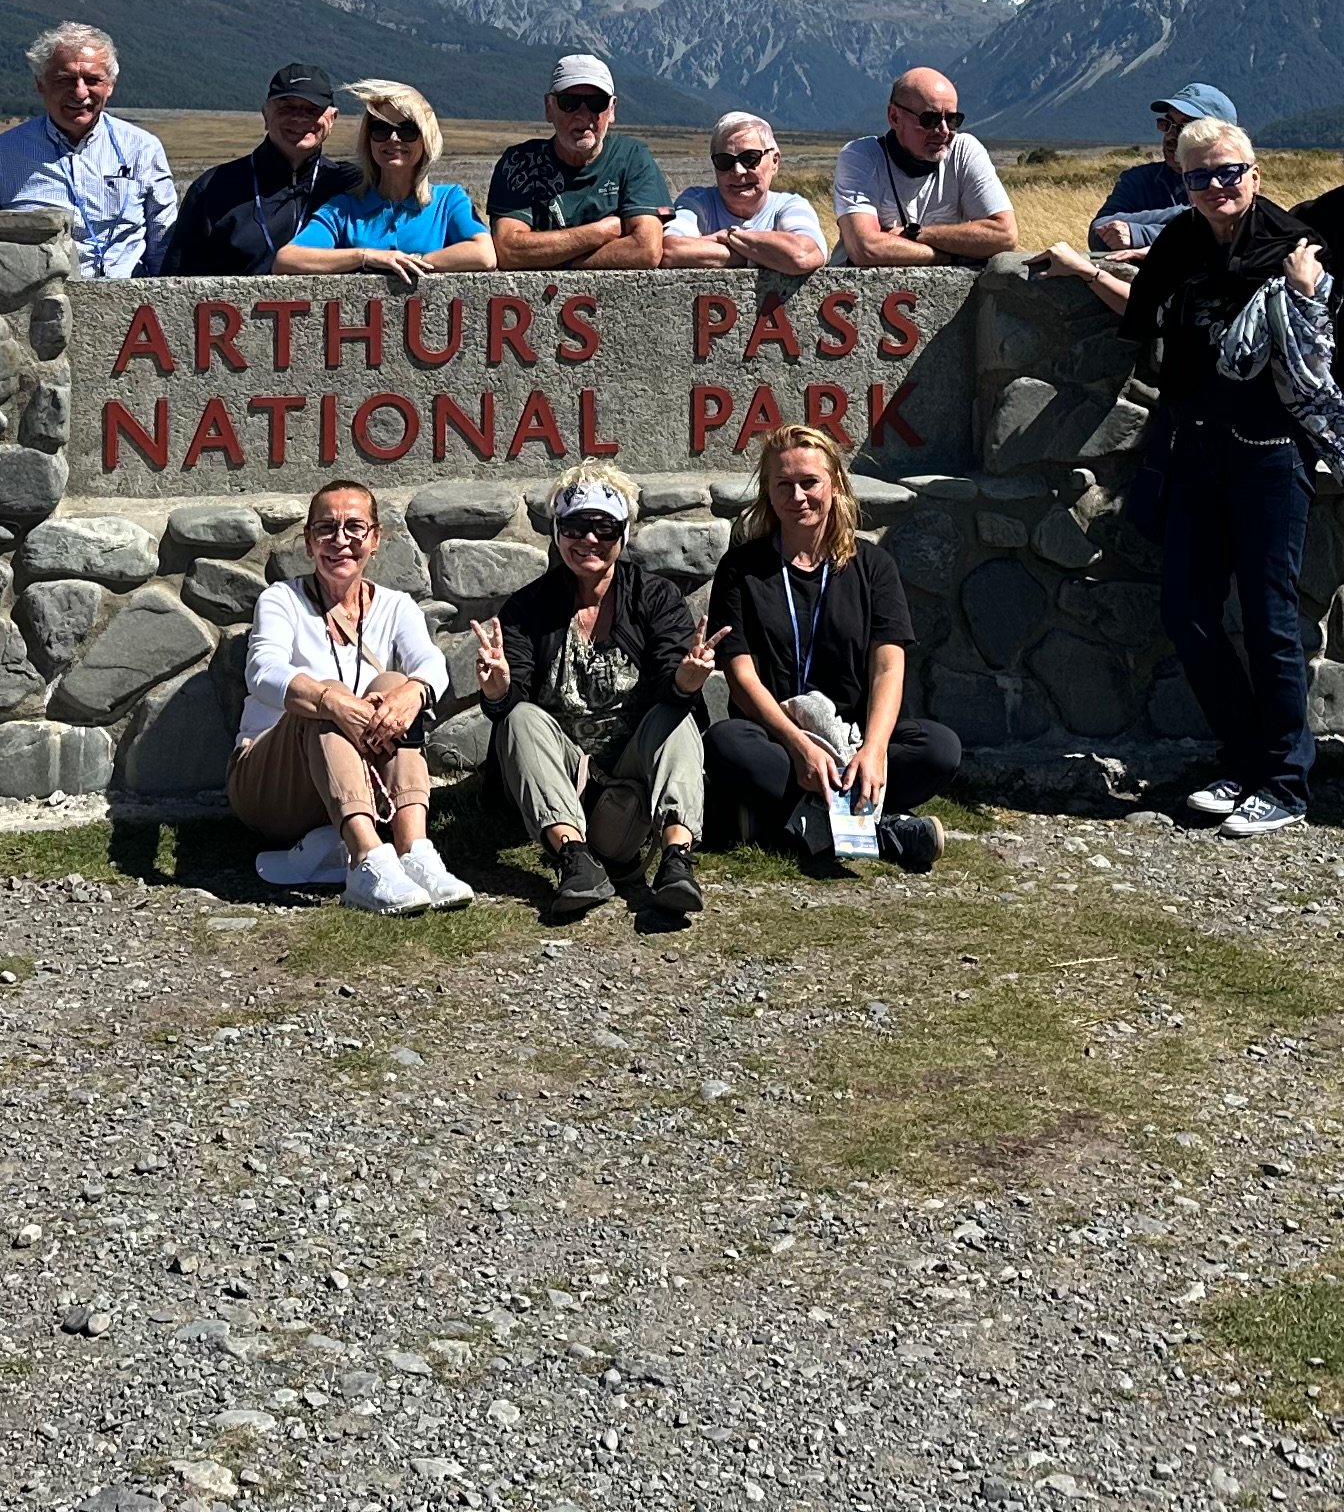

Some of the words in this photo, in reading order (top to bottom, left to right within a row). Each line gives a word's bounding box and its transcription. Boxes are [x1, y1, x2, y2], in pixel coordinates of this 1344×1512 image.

[113, 284, 600, 373] ARTHUR'S
[697, 290, 920, 357] PASS
[104, 389, 619, 470] NATIONAL
[692, 383, 927, 453] PARK
